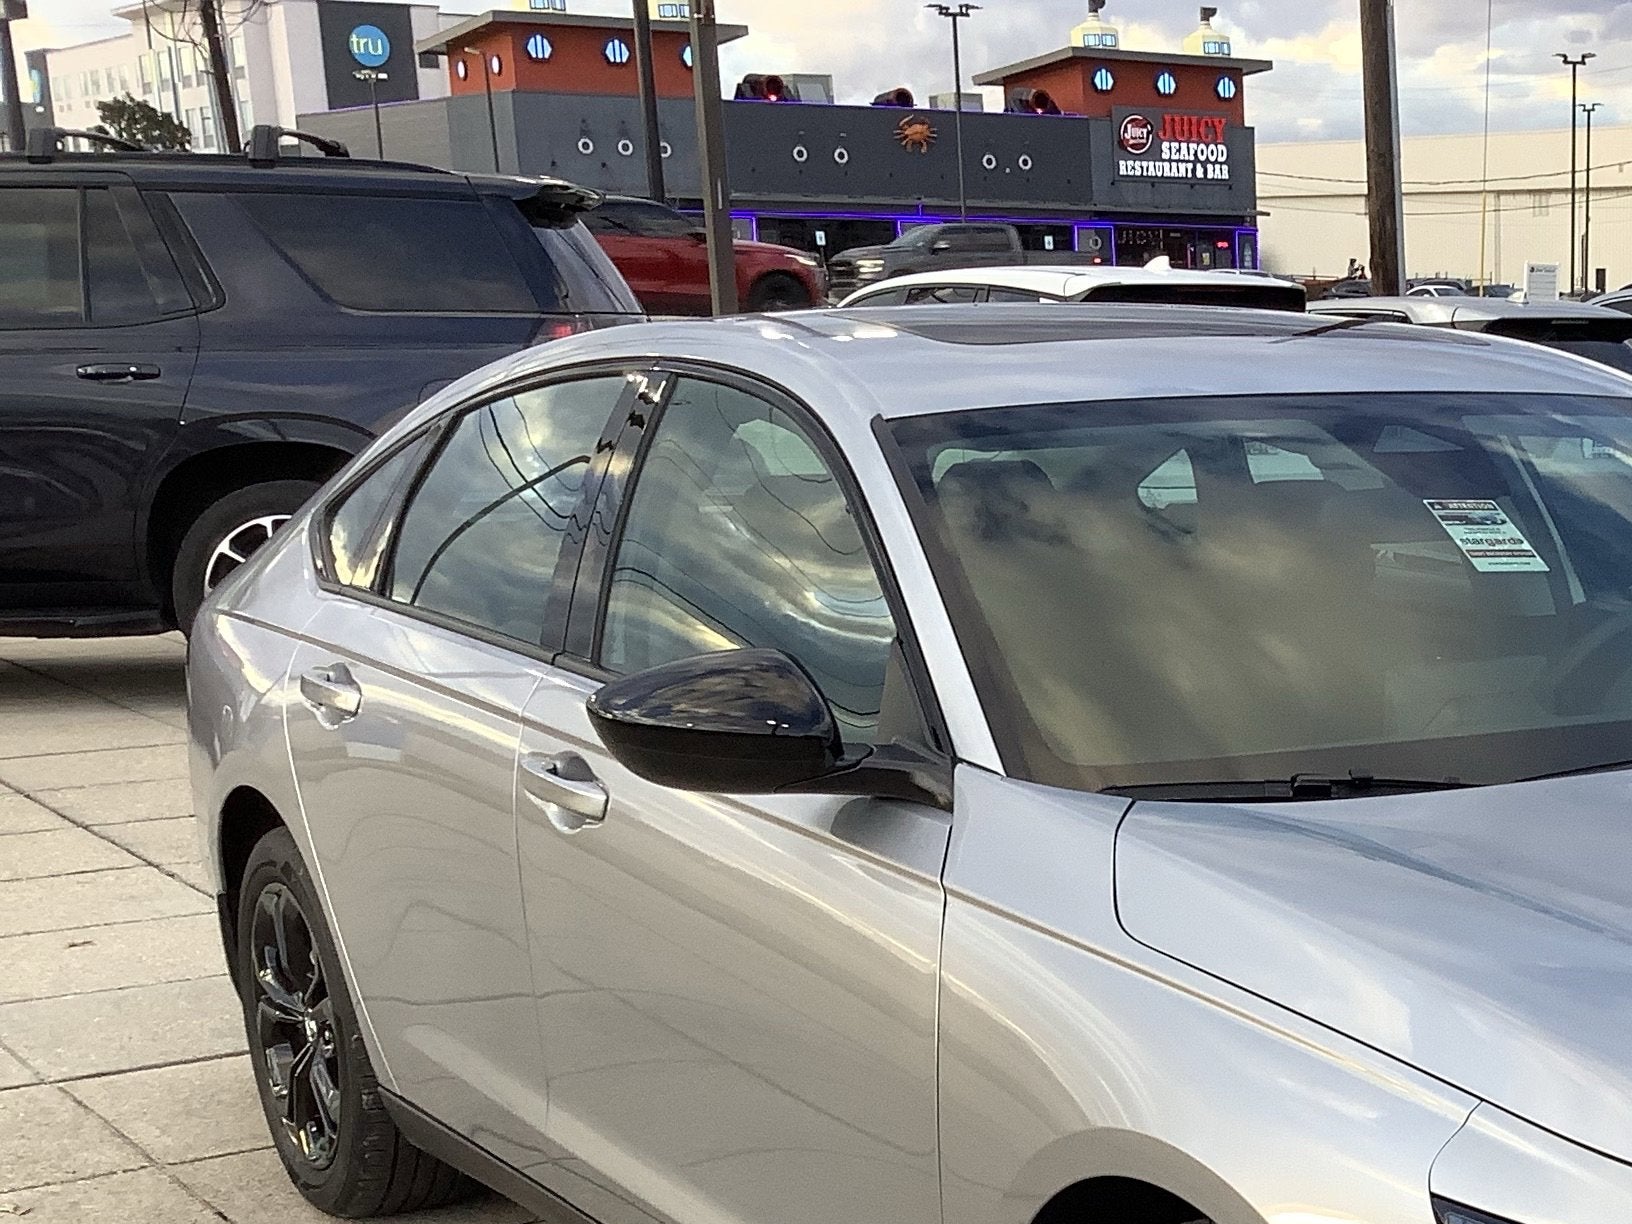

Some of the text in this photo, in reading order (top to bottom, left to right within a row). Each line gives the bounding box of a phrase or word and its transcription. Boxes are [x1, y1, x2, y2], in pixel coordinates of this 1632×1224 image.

[350, 33, 383, 56] tru
[1158, 114, 1227, 143] JUICY
[1161, 141, 1228, 162] SEAFOOD
[1119, 160, 1230, 180] RESTAURANT & BAR
